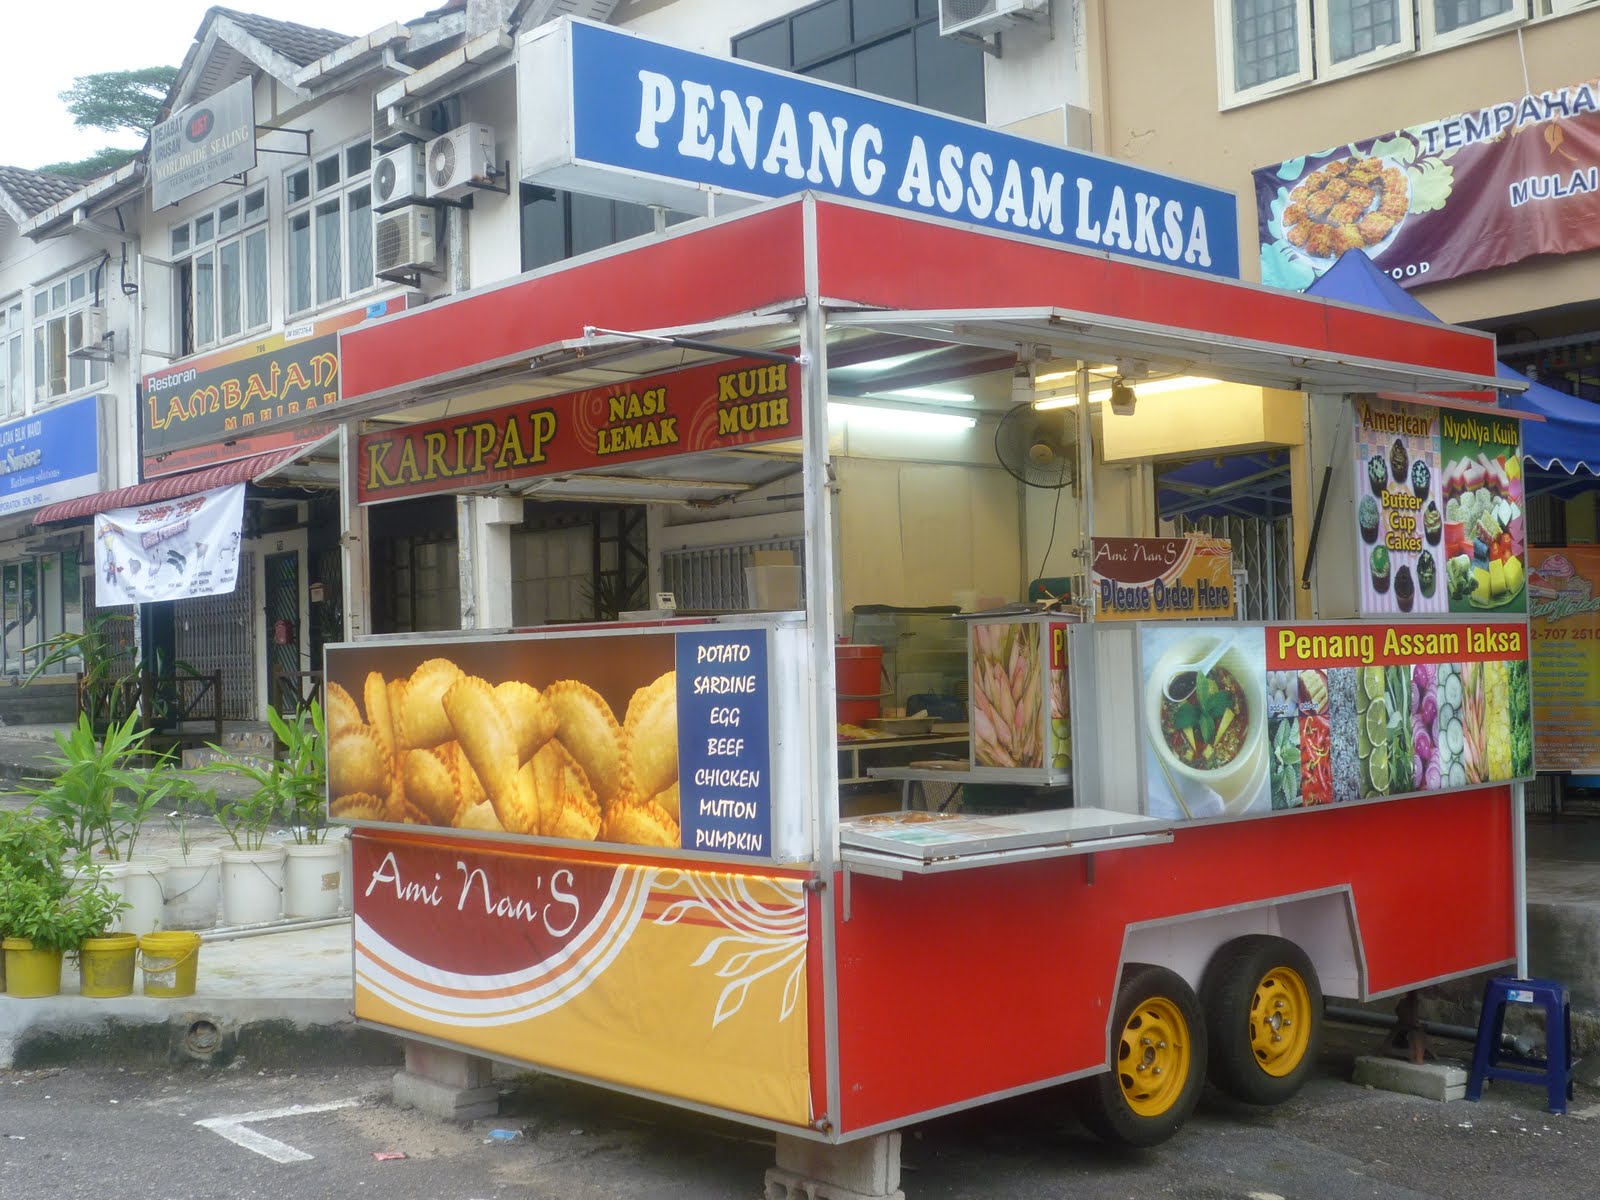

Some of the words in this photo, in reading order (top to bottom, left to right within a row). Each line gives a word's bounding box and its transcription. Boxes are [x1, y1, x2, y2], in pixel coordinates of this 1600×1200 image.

[1421, 84, 1600, 155] TEMPAHA
[155, 145, 207, 178] WORLDWIDE
[210, 125, 249, 153] SEALING
[635, 69, 887, 196] PENANG
[898, 135, 1065, 236] ASSAM
[1074, 177, 1213, 267] LAKSA
[1510, 167, 1598, 208] MULAI
[147, 367, 196, 393] Restoran
[718, 363, 788, 402] KUIH
[608, 387, 666, 422] NASI
[718, 397, 789, 436] MUIH
[597, 417, 679, 456] LEMAK
[1443, 415, 1490, 447] NyoNya
[1492, 422, 1518, 446] Kuih
[366, 410, 557, 490] KARIPAP
[1381, 490, 1423, 509] Butter
[1389, 512, 1416, 531] Cup
[1094, 543, 1128, 562] Ami
[1385, 532, 1423, 551] Cakes
[1100, 578, 1150, 612] Please
[1153, 578, 1195, 610] Order
[1196, 578, 1229, 608] Here
[697, 644, 750, 664] POTATO
[1053, 628, 1068, 667] P
[1278, 629, 1375, 664] Penang
[1383, 628, 1459, 657] Assam
[1466, 626, 1521, 653] laksa
[693, 675, 756, 695] SARDINE
[710, 707, 741, 728] EGG
[707, 738, 744, 757] BEEF
[694, 769, 760, 788] CHICKEN
[699, 798, 757, 820] MUTTON
[695, 829, 762, 851] PUMPKIN
[365, 851, 443, 907] Ami
